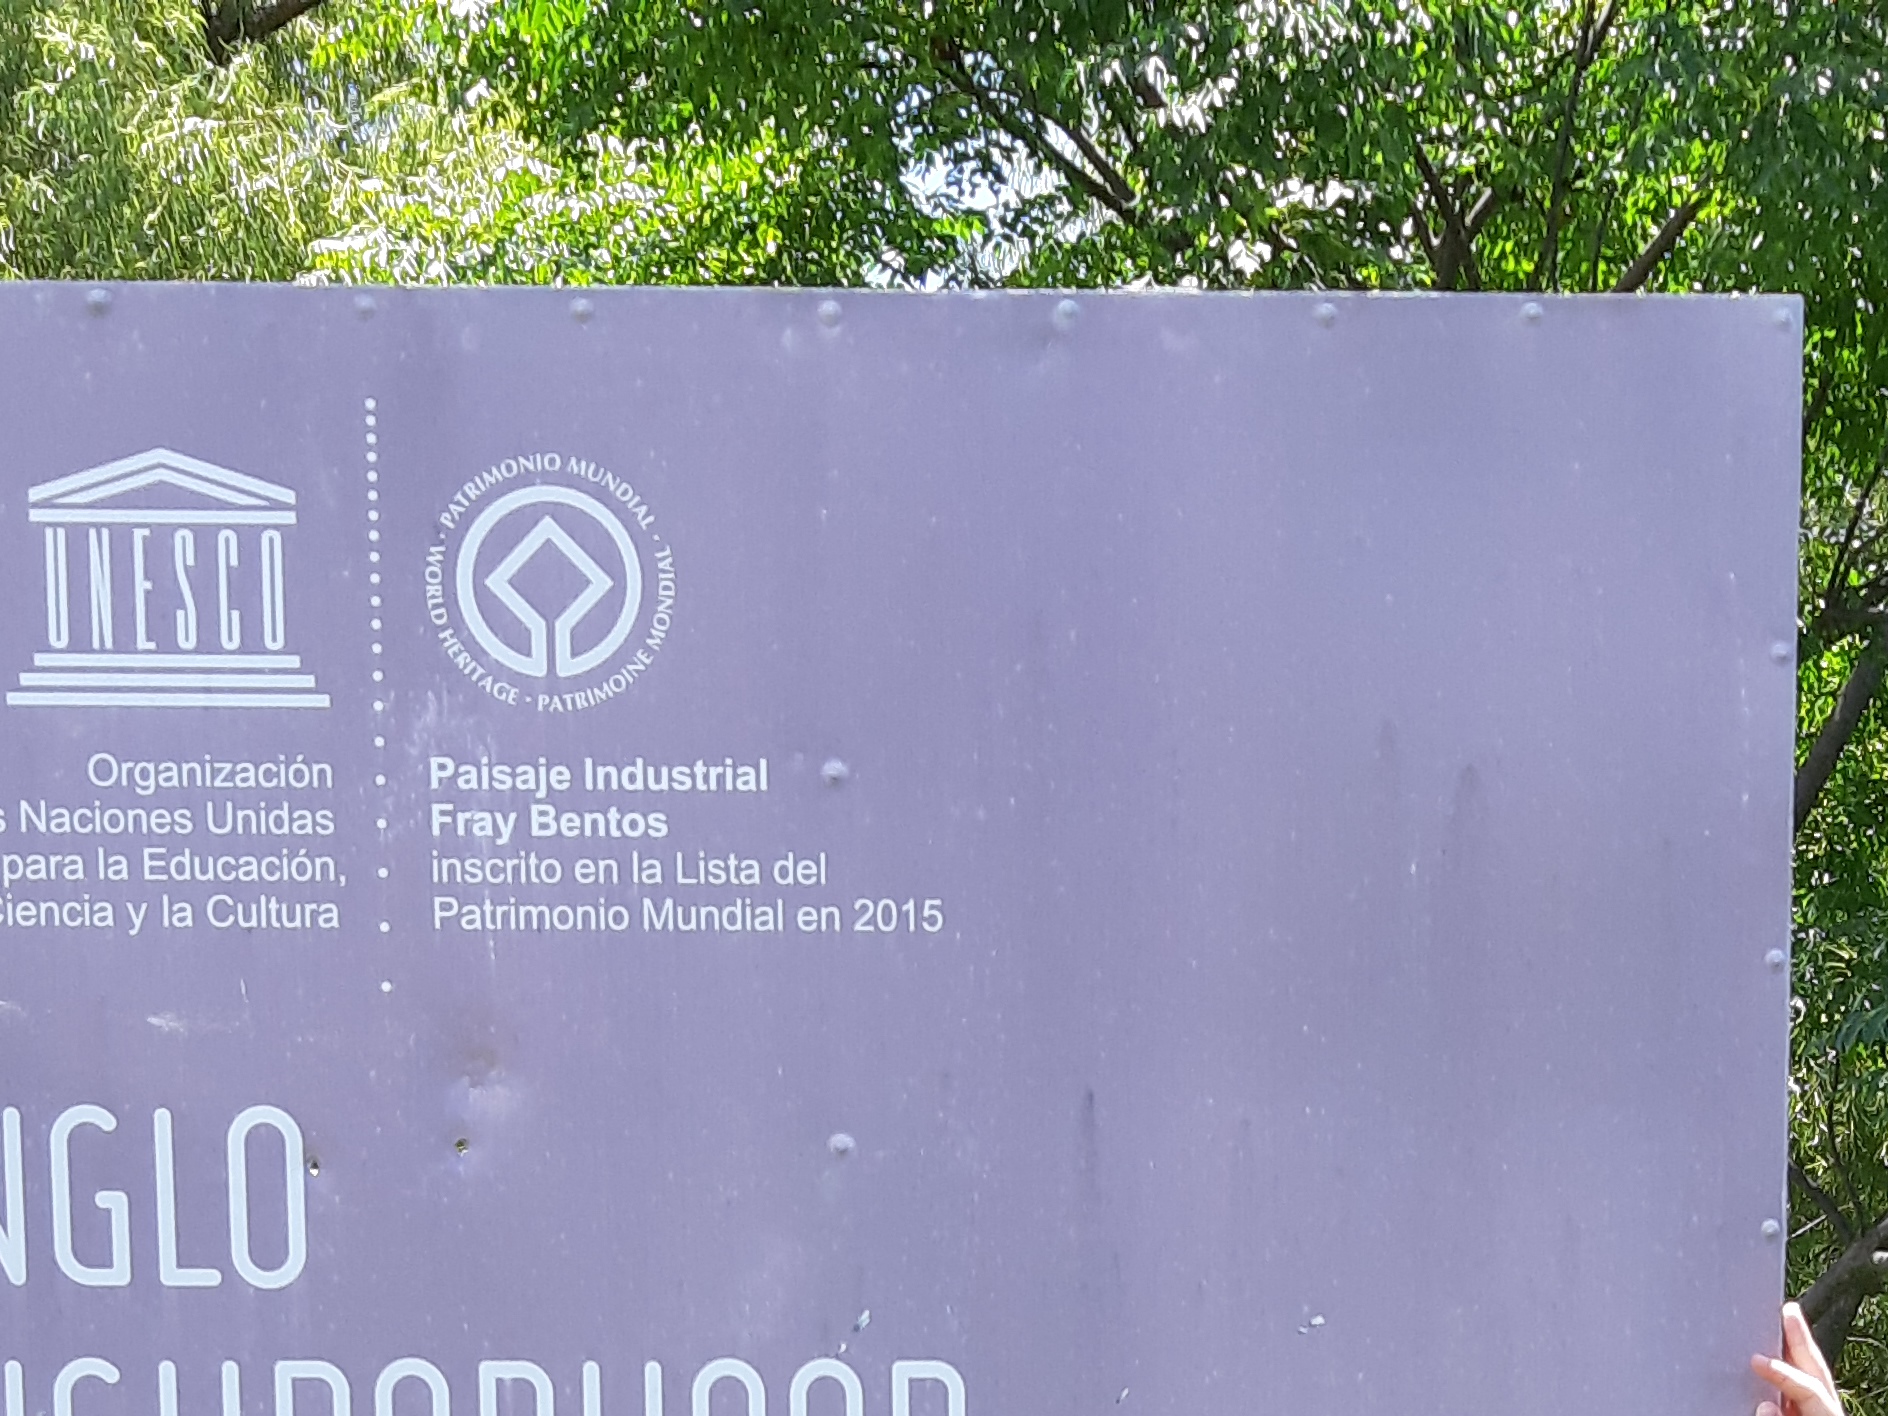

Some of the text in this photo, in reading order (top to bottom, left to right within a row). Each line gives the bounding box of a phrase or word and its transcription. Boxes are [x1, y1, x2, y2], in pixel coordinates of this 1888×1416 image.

[438, 452, 656, 531] PATRIMONIO MUNDIAL
[42, 526, 287, 652] UNESCO
[423, 545, 520, 706] WORLD HERITAGE
[536, 545, 677, 713] PATRIMOINE MONDIAL
[87, 752, 334, 797] Organización
[429, 755, 769, 799] Paisaje Industrial
[19, 799, 194, 836] Naciones
[206, 800, 336, 836] Unidas
[430, 803, 670, 846] Fray Bentos
[2, 846, 348, 890] para la Educación,
[431, 850, 827, 886] inscrito en la Lista del
[125, 902, 149, 936] y
[162, 893, 194, 928] la
[206, 894, 341, 930] Cultura
[433, 896, 944, 933] Patrimonio Mundial en 2015
